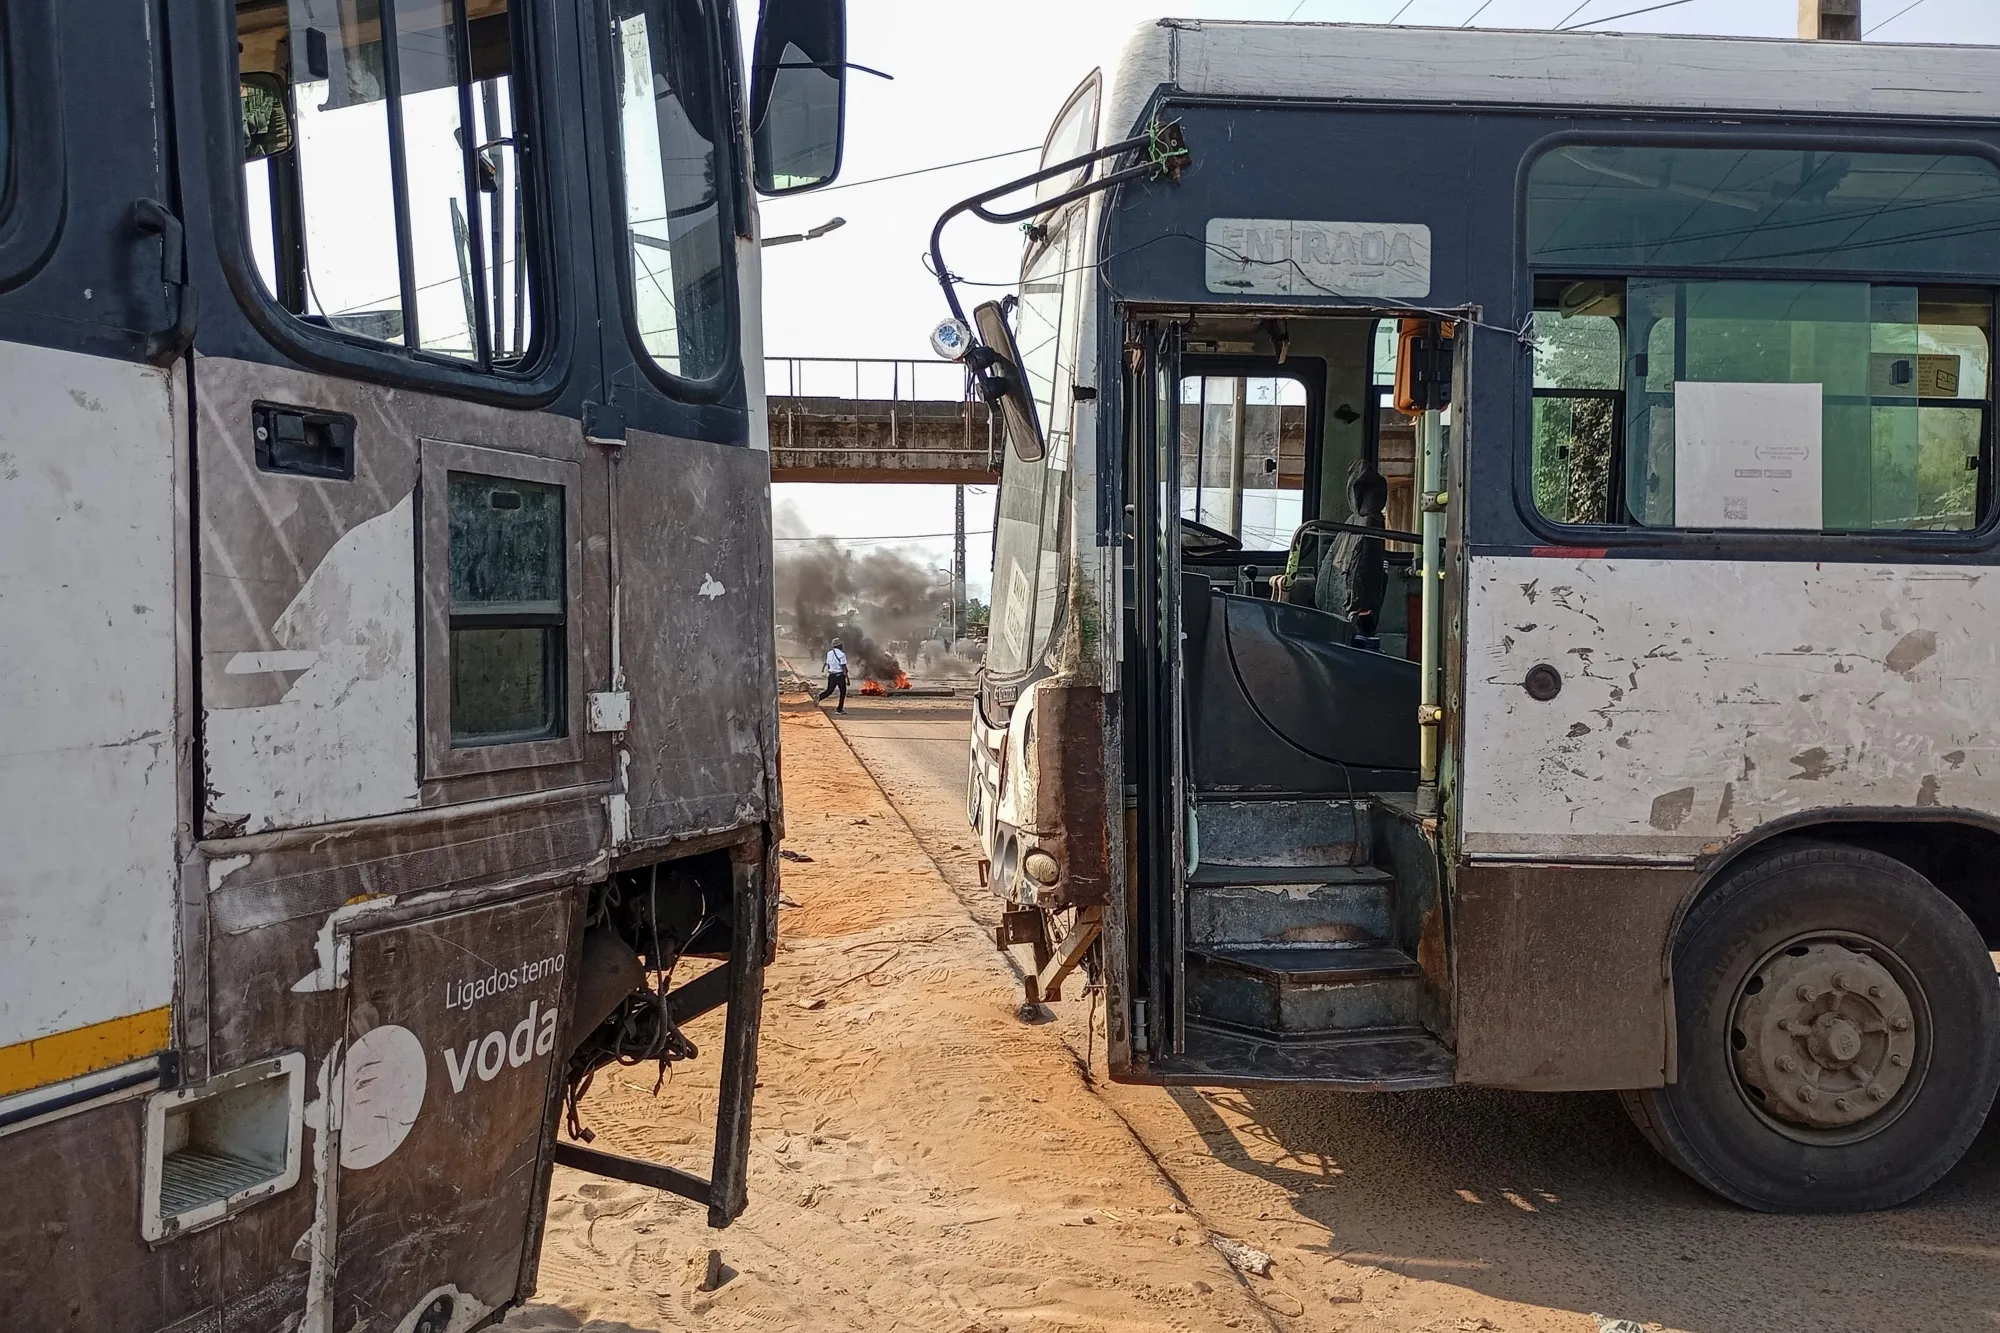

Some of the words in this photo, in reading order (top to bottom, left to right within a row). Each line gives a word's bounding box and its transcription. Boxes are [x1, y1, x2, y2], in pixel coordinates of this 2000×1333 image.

[1221, 227, 1415, 266] ENTRADA
[446, 967, 518, 1010] Ligados
[522, 953, 565, 985] temo
[443, 999, 559, 1094] voda
